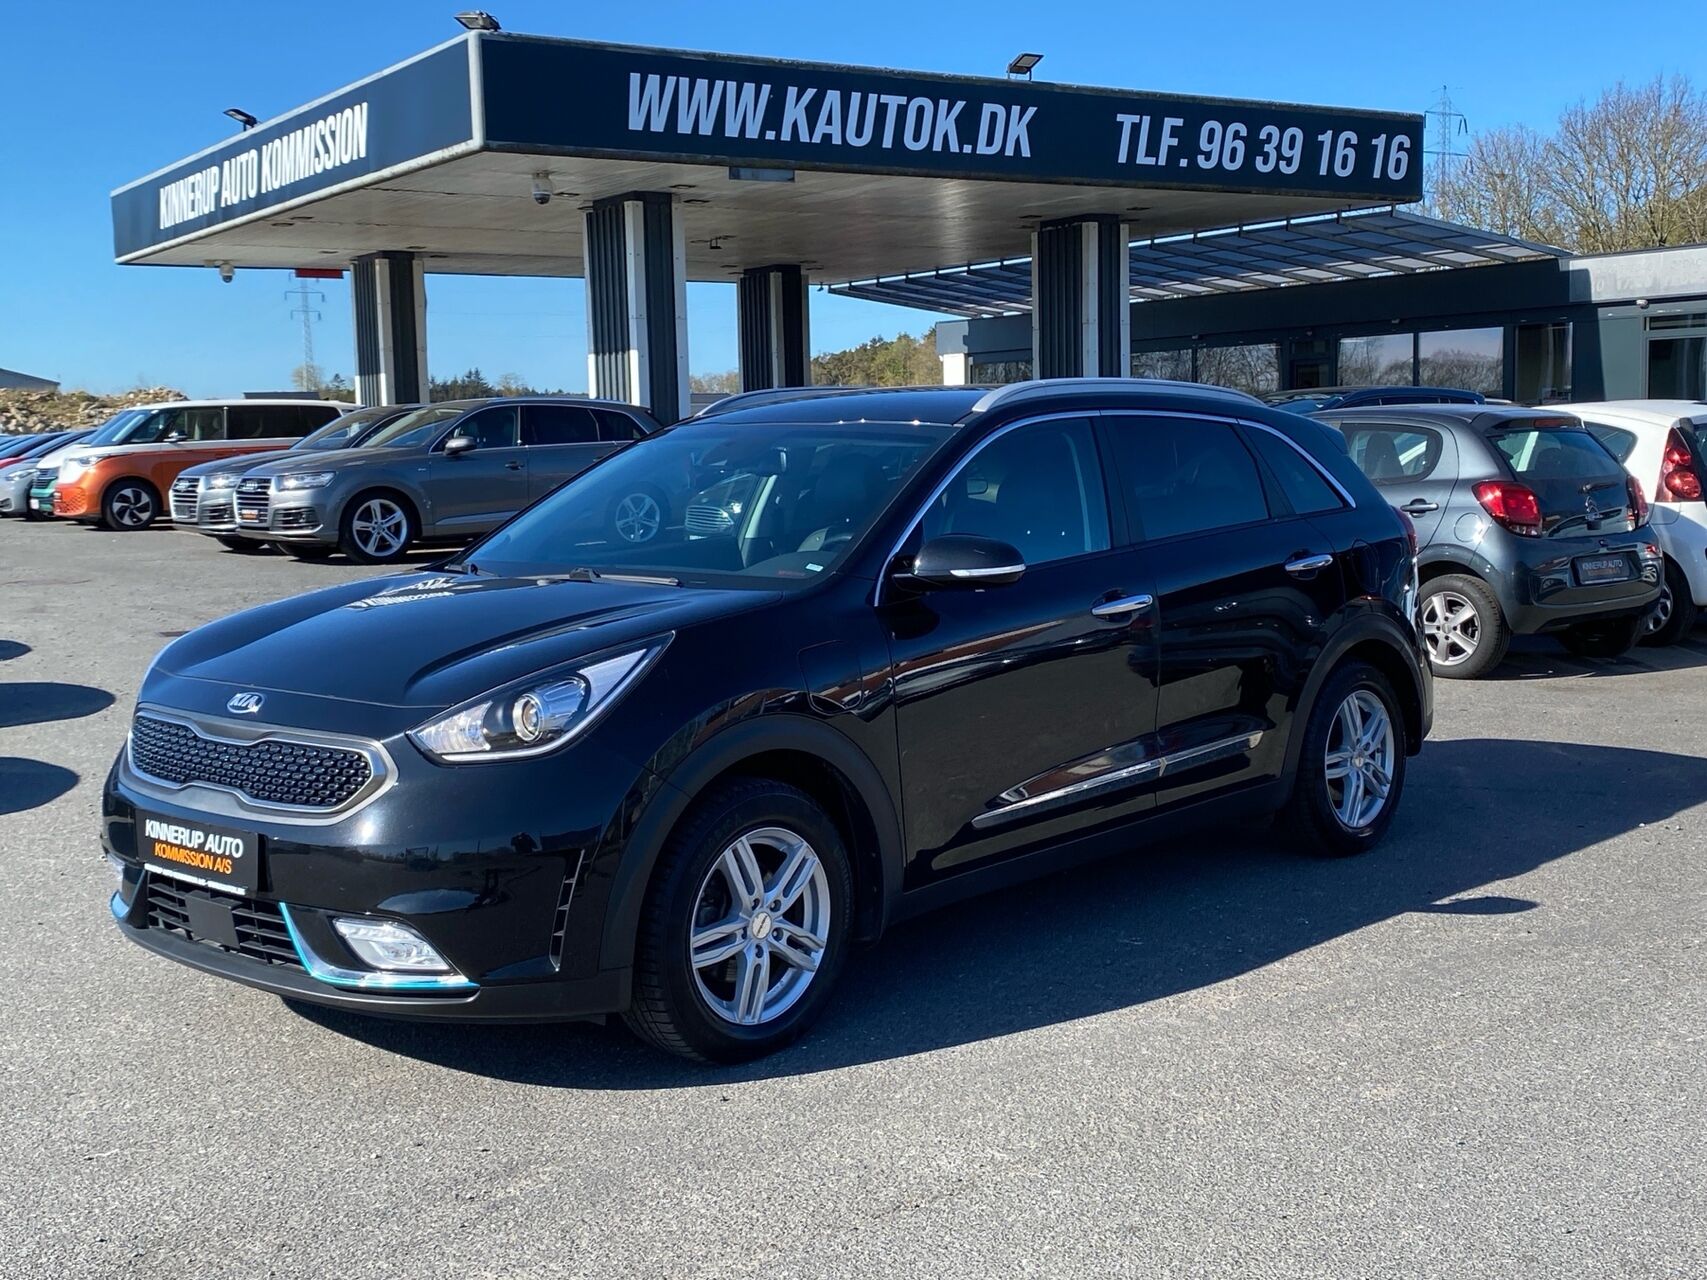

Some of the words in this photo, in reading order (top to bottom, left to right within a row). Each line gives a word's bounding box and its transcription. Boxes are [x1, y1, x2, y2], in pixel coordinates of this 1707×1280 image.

[628, 72, 1038, 157] WWW.KAUTOK.DK
[160, 166, 219, 229] KINNERUP
[220, 149, 258, 207] AUTO
[261, 102, 368, 193] KOMMISSION
[1116, 113, 1188, 168] TLF.
[1197, 120, 1248, 171] 96
[1255, 125, 1304, 175] 39
[1317, 130, 1358, 177] 16
[1371, 134, 1411, 180] 16
[229, 693, 259, 709] KIA
[145, 819, 204, 848] KINNERUP
[204, 833, 244, 858] AUTO
[155, 842, 213, 869] KOMMISSION
[214, 857, 232, 874] A/S
